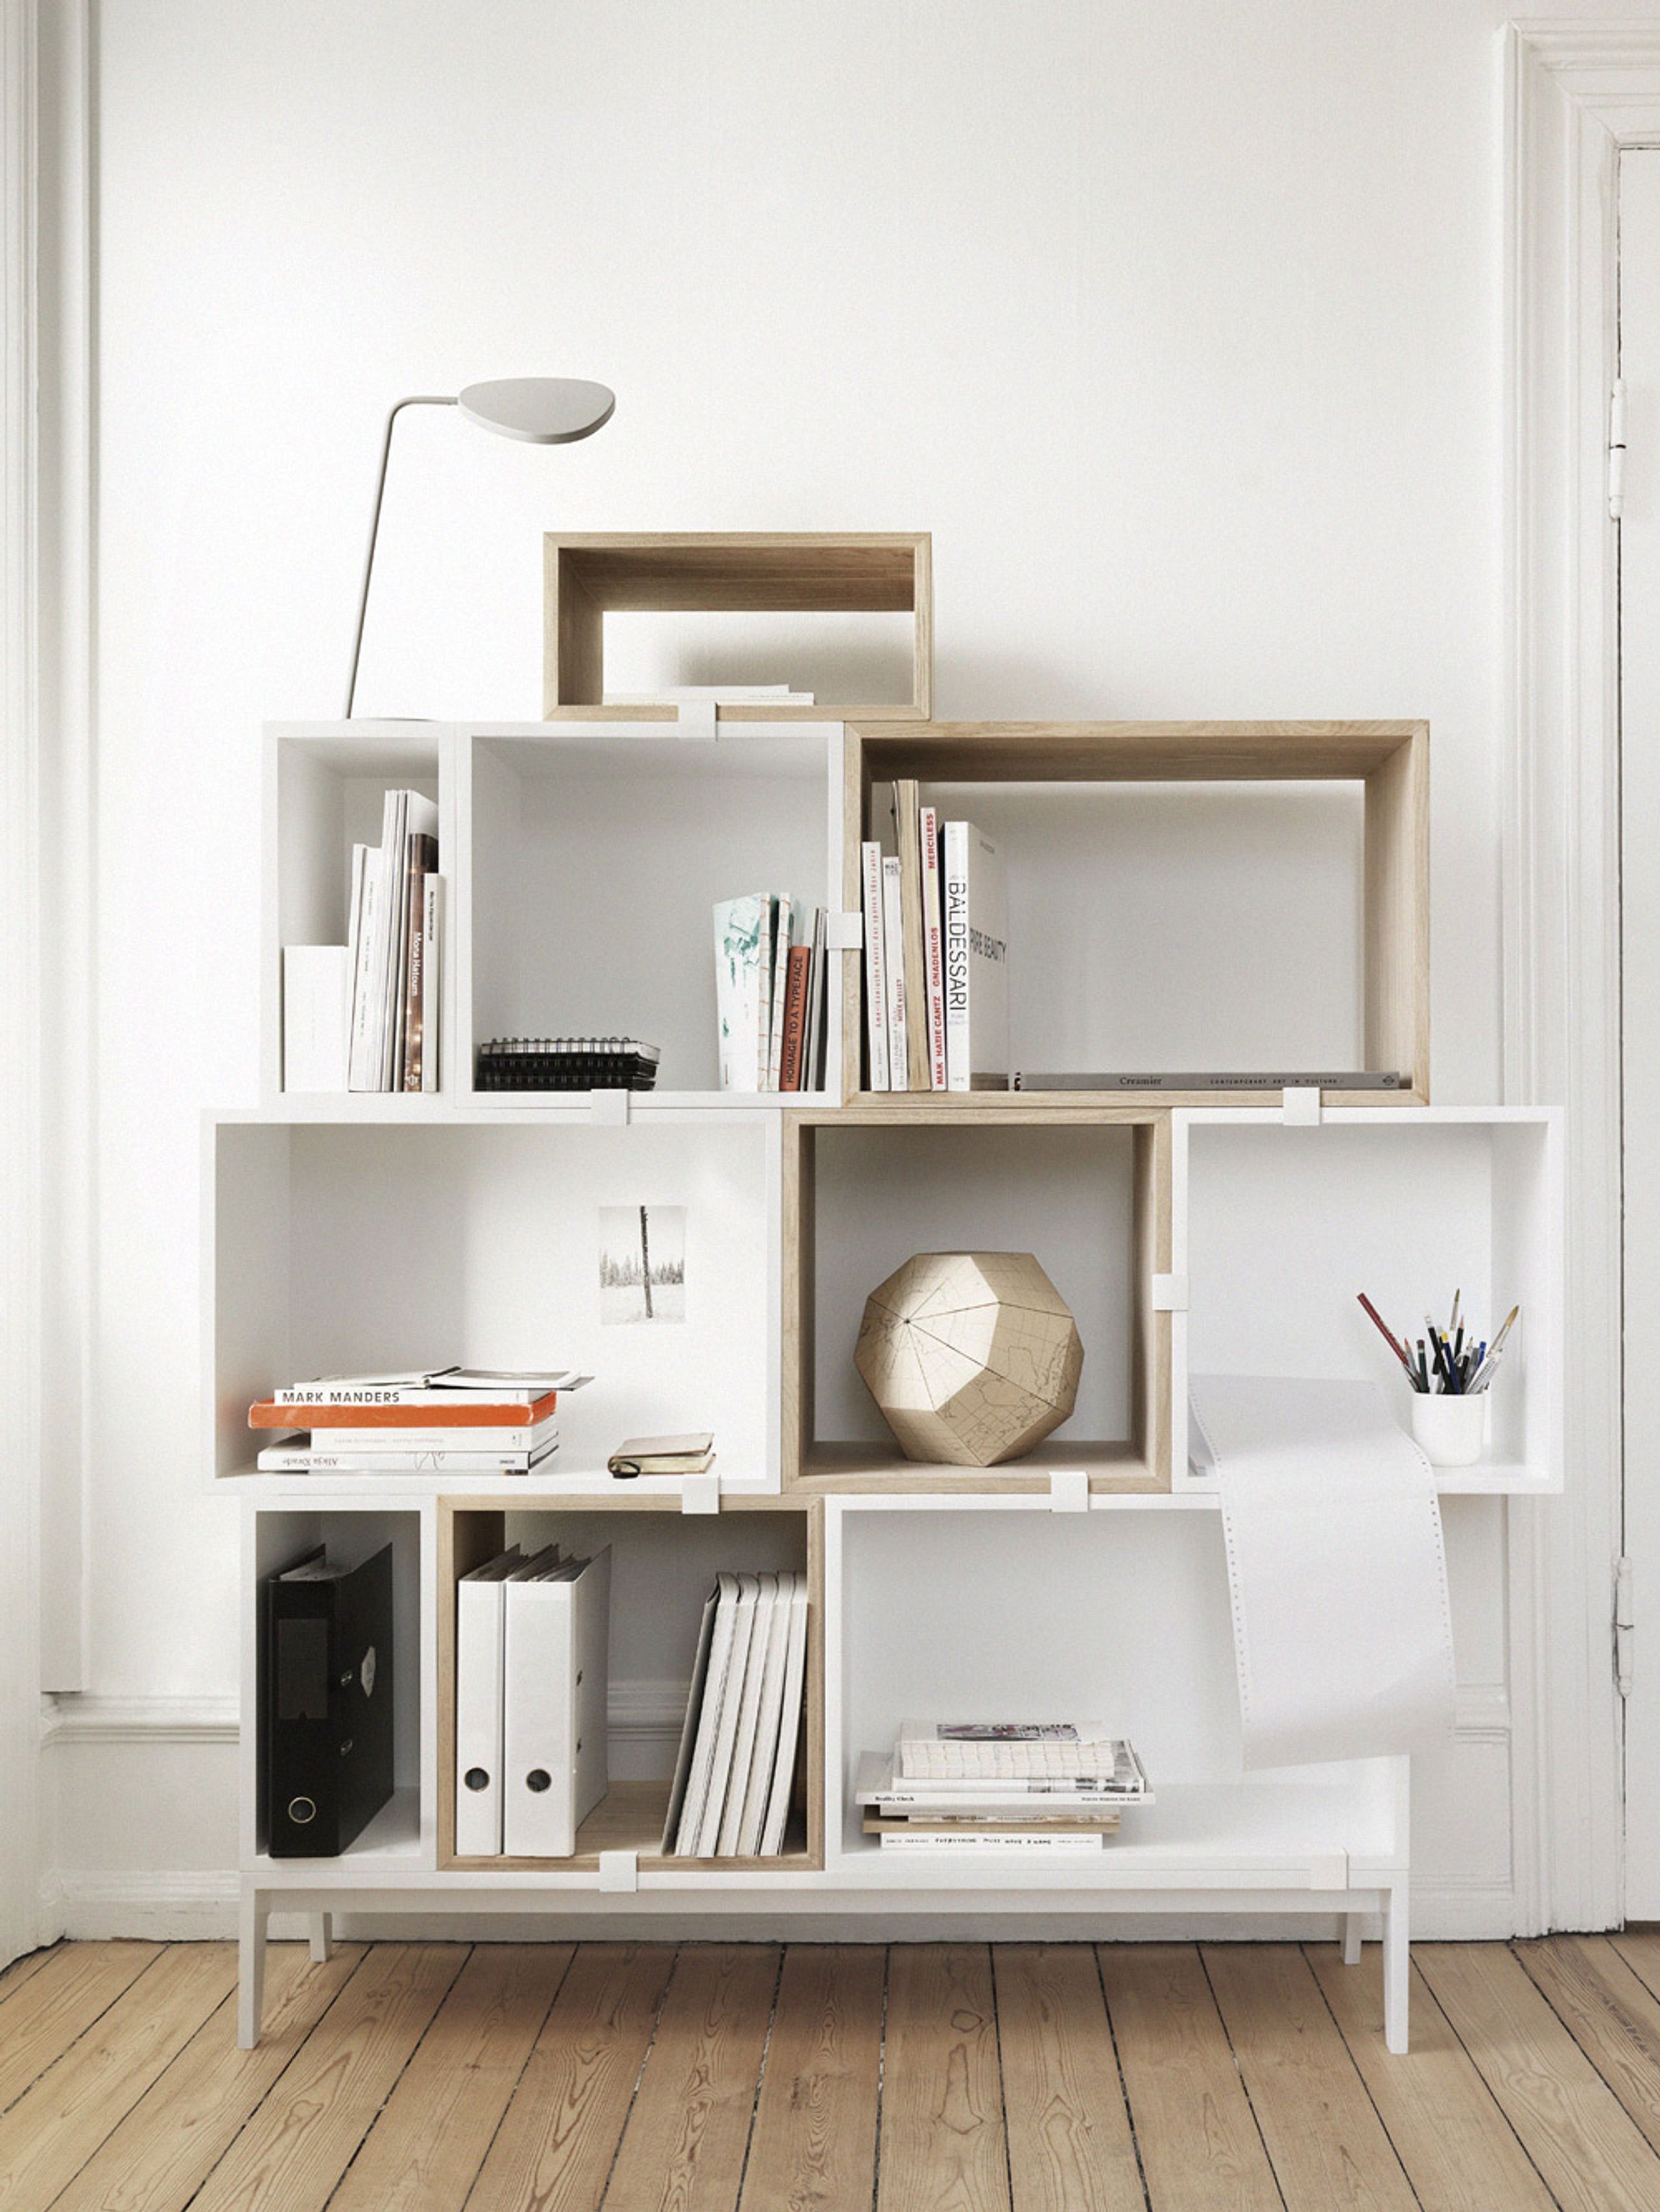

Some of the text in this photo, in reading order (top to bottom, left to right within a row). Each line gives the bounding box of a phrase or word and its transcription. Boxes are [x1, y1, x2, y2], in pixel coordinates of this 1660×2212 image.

[926, 813, 936, 869] MERCILESS
[931, 927, 940, 987] GNADENLOS
[949, 883, 966, 1010] BALDESSARI
[792, 956, 803, 1007] TYPEFACE
[789, 1020, 798, 1034] TO
[786, 1039, 798, 1083] HOMAGE
[1119, 1076, 1162, 1085] Creamier
[282, 1392, 400, 1402] MARK MANDERS
